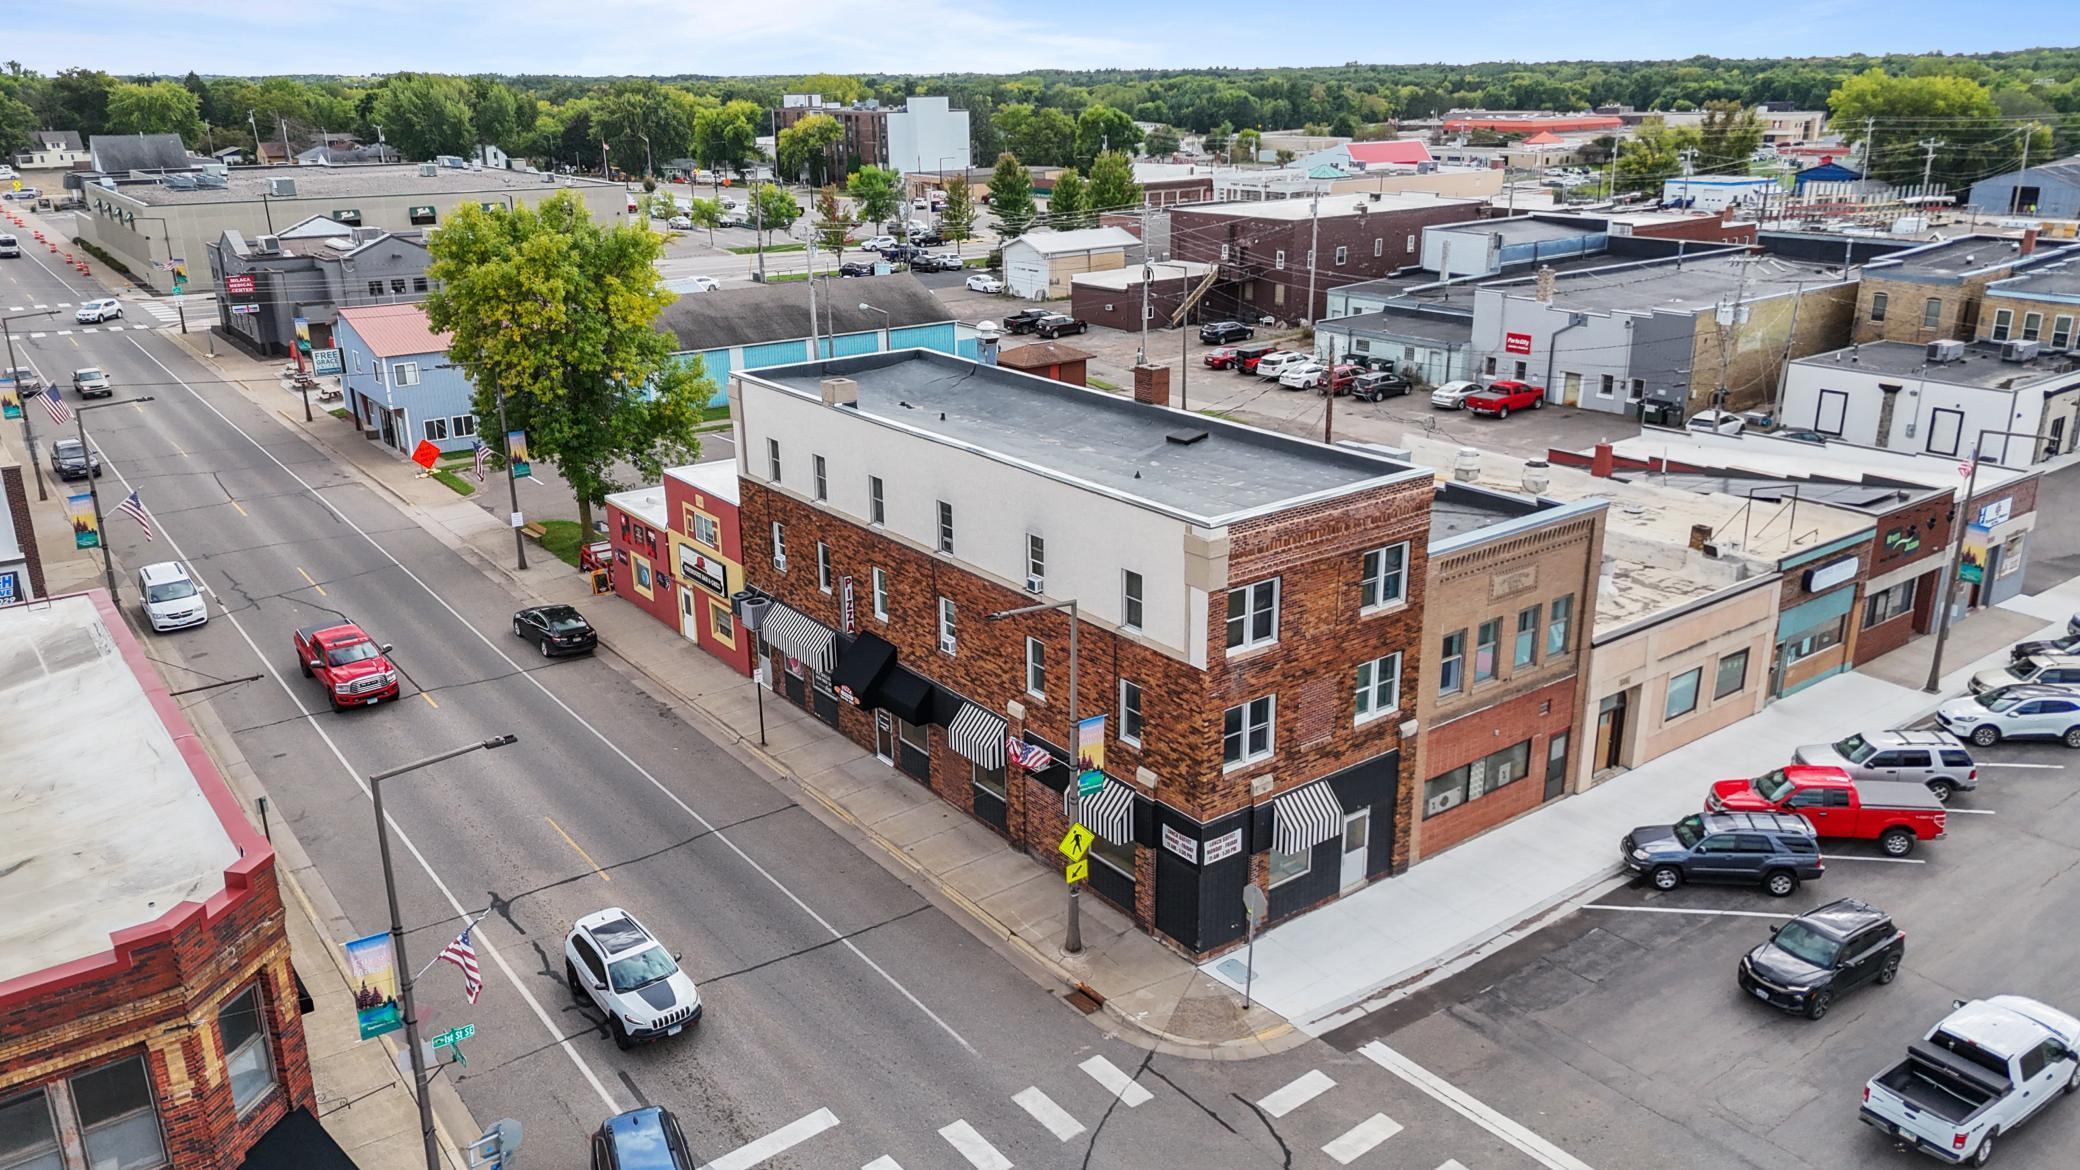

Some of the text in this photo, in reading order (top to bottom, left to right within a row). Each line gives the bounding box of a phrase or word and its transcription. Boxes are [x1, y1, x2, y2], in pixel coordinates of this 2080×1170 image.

[314, 351, 337, 360] FREE
[844, 577, 855, 633] PIZZA
[1165, 833, 1180, 846] MONDAY
[1181, 842, 1194, 853] FRIDAY
[1167, 829, 1192, 844] LUNCH BUFFET
[1209, 832, 1236, 848] LUNCH BUFFET
[1206, 845, 1223, 855] MONDAY
[1224, 838, 1238, 848] FRIDAY
[444, 1026, 474, 1044] 1st St SE
